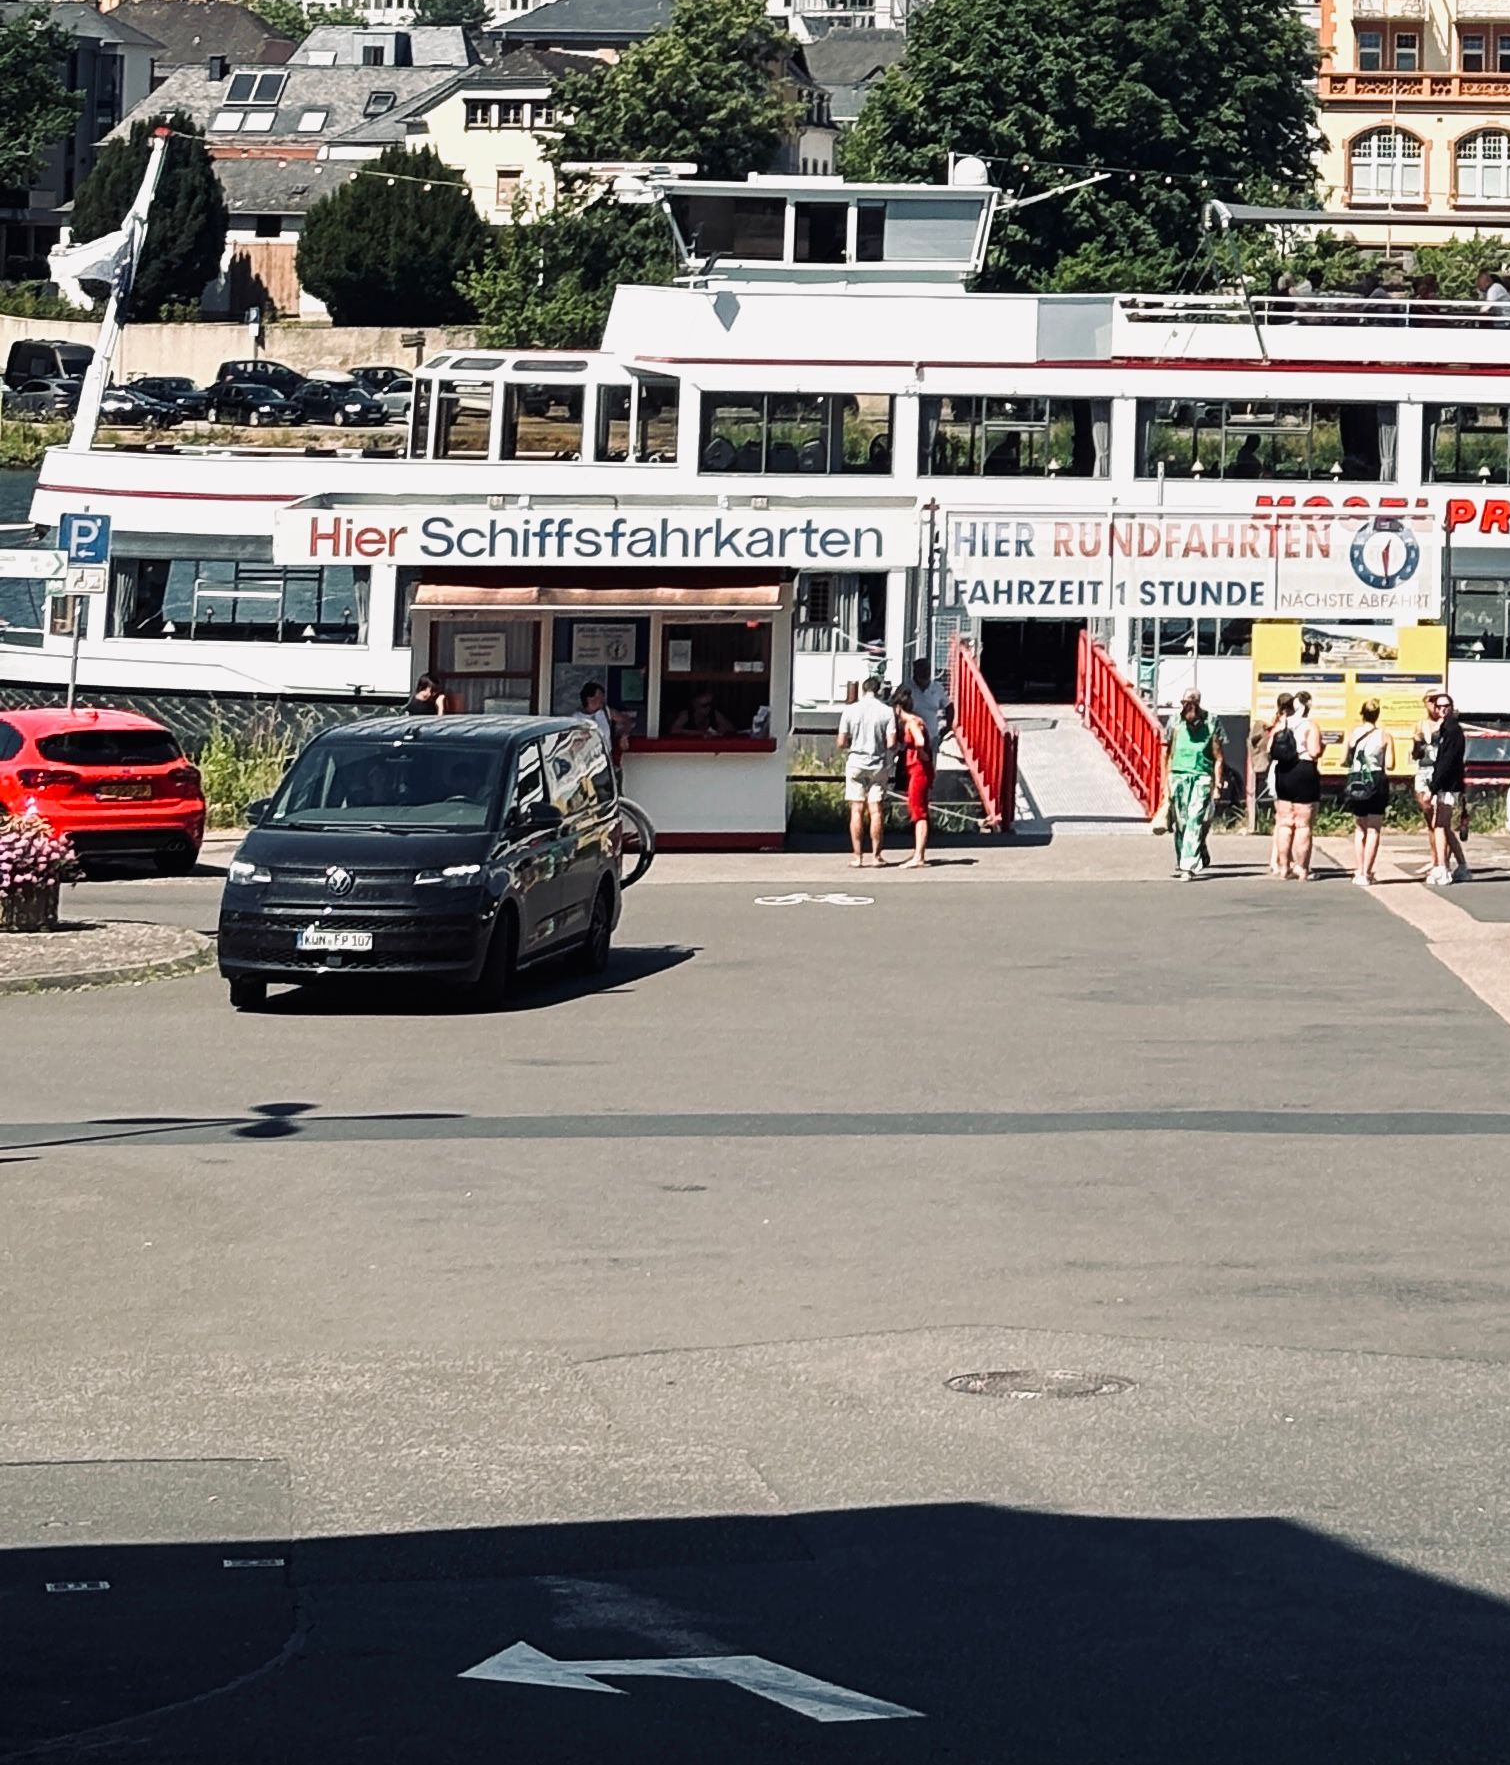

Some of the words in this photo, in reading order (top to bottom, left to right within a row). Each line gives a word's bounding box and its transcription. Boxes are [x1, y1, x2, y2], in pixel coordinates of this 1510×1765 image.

[70, 519, 99, 557] P
[308, 516, 408, 557] Hier
[419, 516, 884, 559] Schiffsfahrkarten
[953, 522, 1036, 558] HIER
[1053, 521, 1331, 559] RUNDFAHRTEN
[953, 579, 1103, 606] FAHRZEIT
[1113, 580, 1127, 606] 1
[1139, 580, 1266, 607] STUNDE
[1280, 590, 1354, 608] NÄCHSTE
[1358, 592, 1431, 609] ABFAHRT
[352, 936, 372, 947] 107
